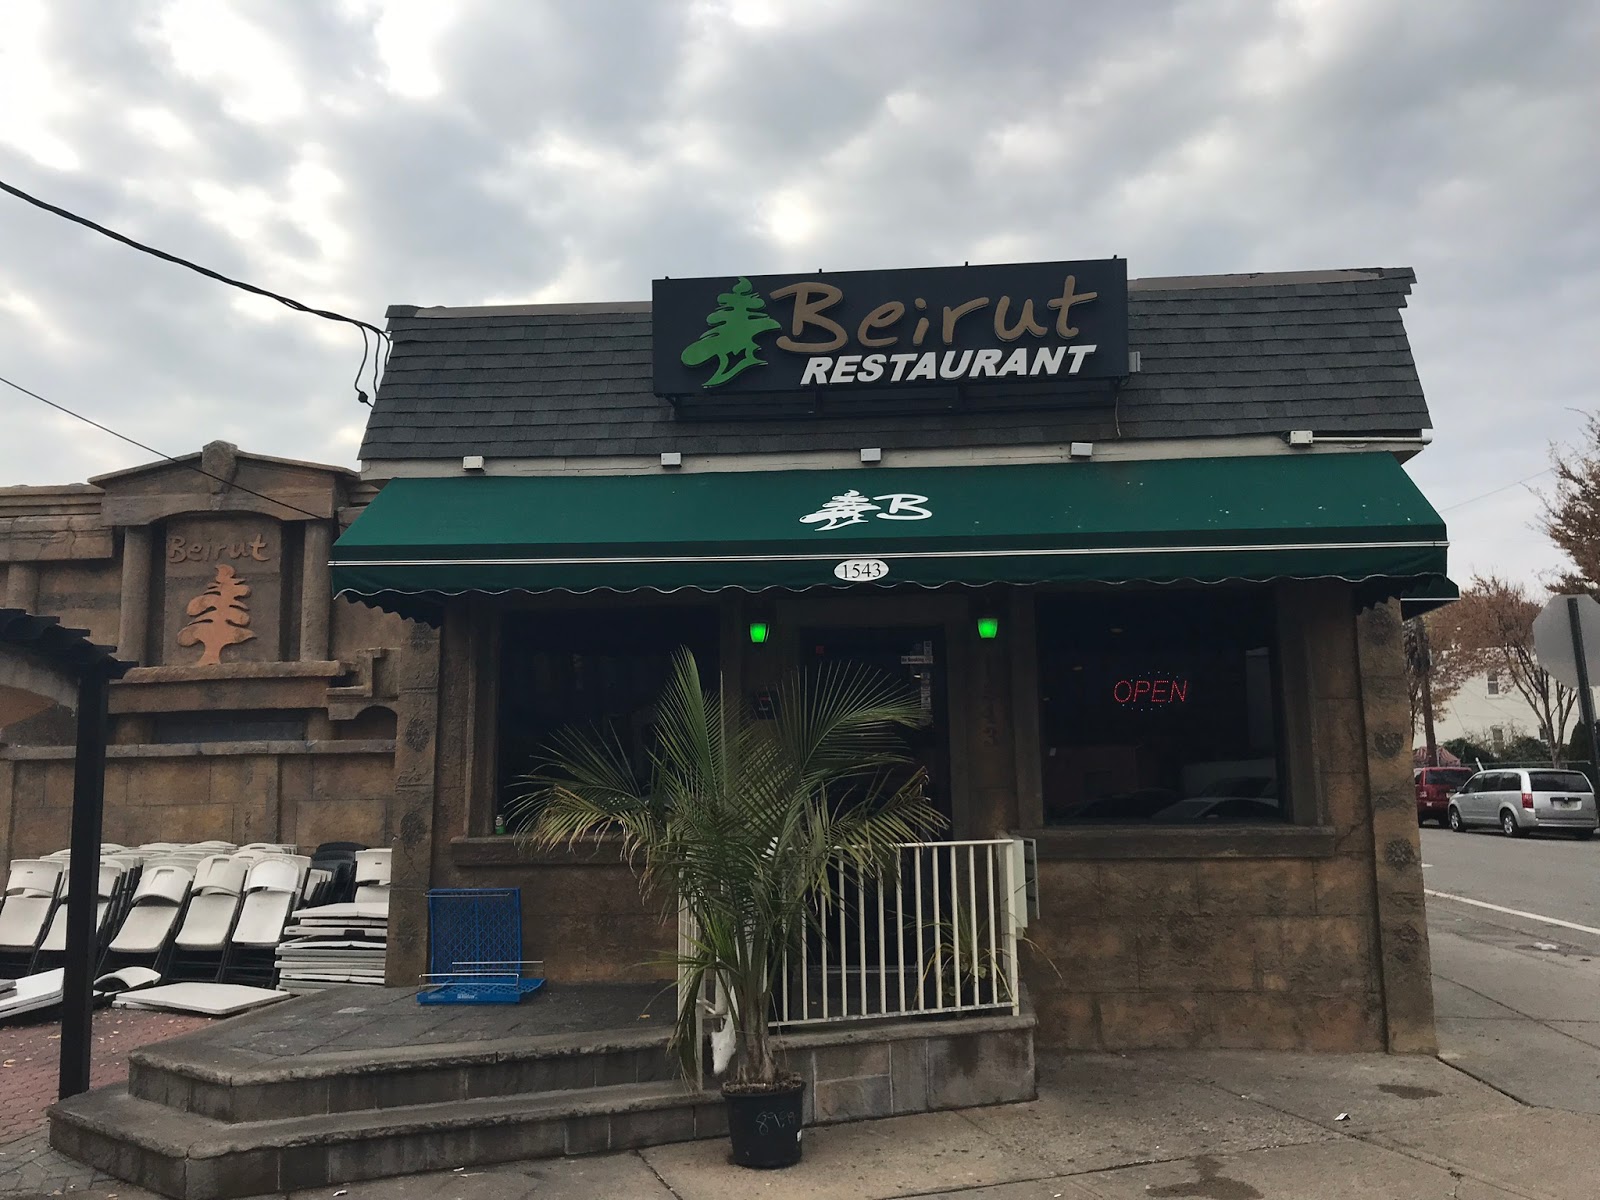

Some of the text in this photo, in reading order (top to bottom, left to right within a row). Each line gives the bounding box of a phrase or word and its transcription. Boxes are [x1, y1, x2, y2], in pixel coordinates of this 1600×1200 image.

[770, 275, 1098, 353] Beirut
[800, 344, 1097, 385] RESTAURANT
[873, 494, 932, 520] B
[168, 534, 270, 563] Beirut
[843, 563, 881, 578] 1543
[1114, 680, 1187, 702] OPEN
